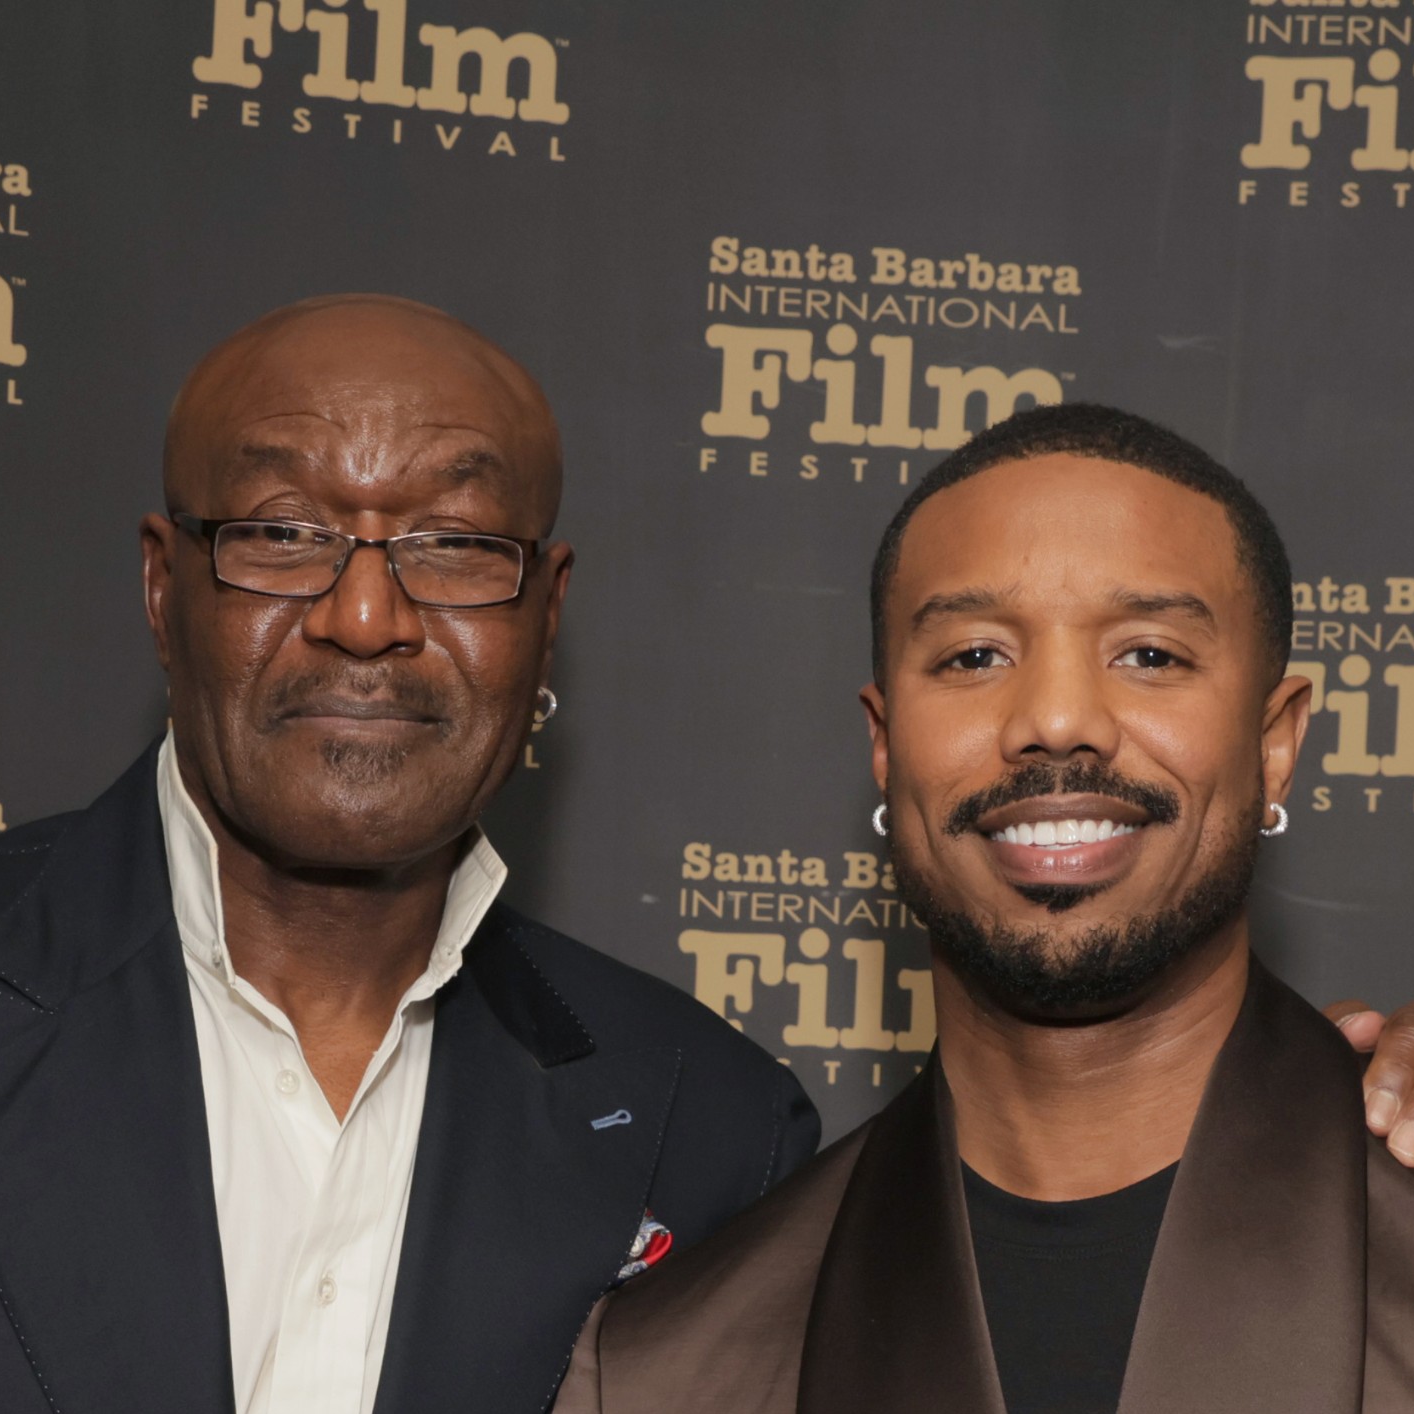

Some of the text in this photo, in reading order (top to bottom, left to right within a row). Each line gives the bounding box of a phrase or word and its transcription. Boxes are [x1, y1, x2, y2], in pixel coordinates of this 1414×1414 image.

[193, 0, 570, 124] Film
[192, 95, 565, 160] FESTIVAL
[710, 236, 1081, 295] Santa Barbara
[708, 283, 1075, 332] INTERNATIONAL
[701, 324, 1063, 449] Film
[700, 448, 908, 483] FESTI
[1292, 576, 1370, 613] nta
[683, 843, 830, 886] Santa
[680, 888, 930, 931] INTERNATI
